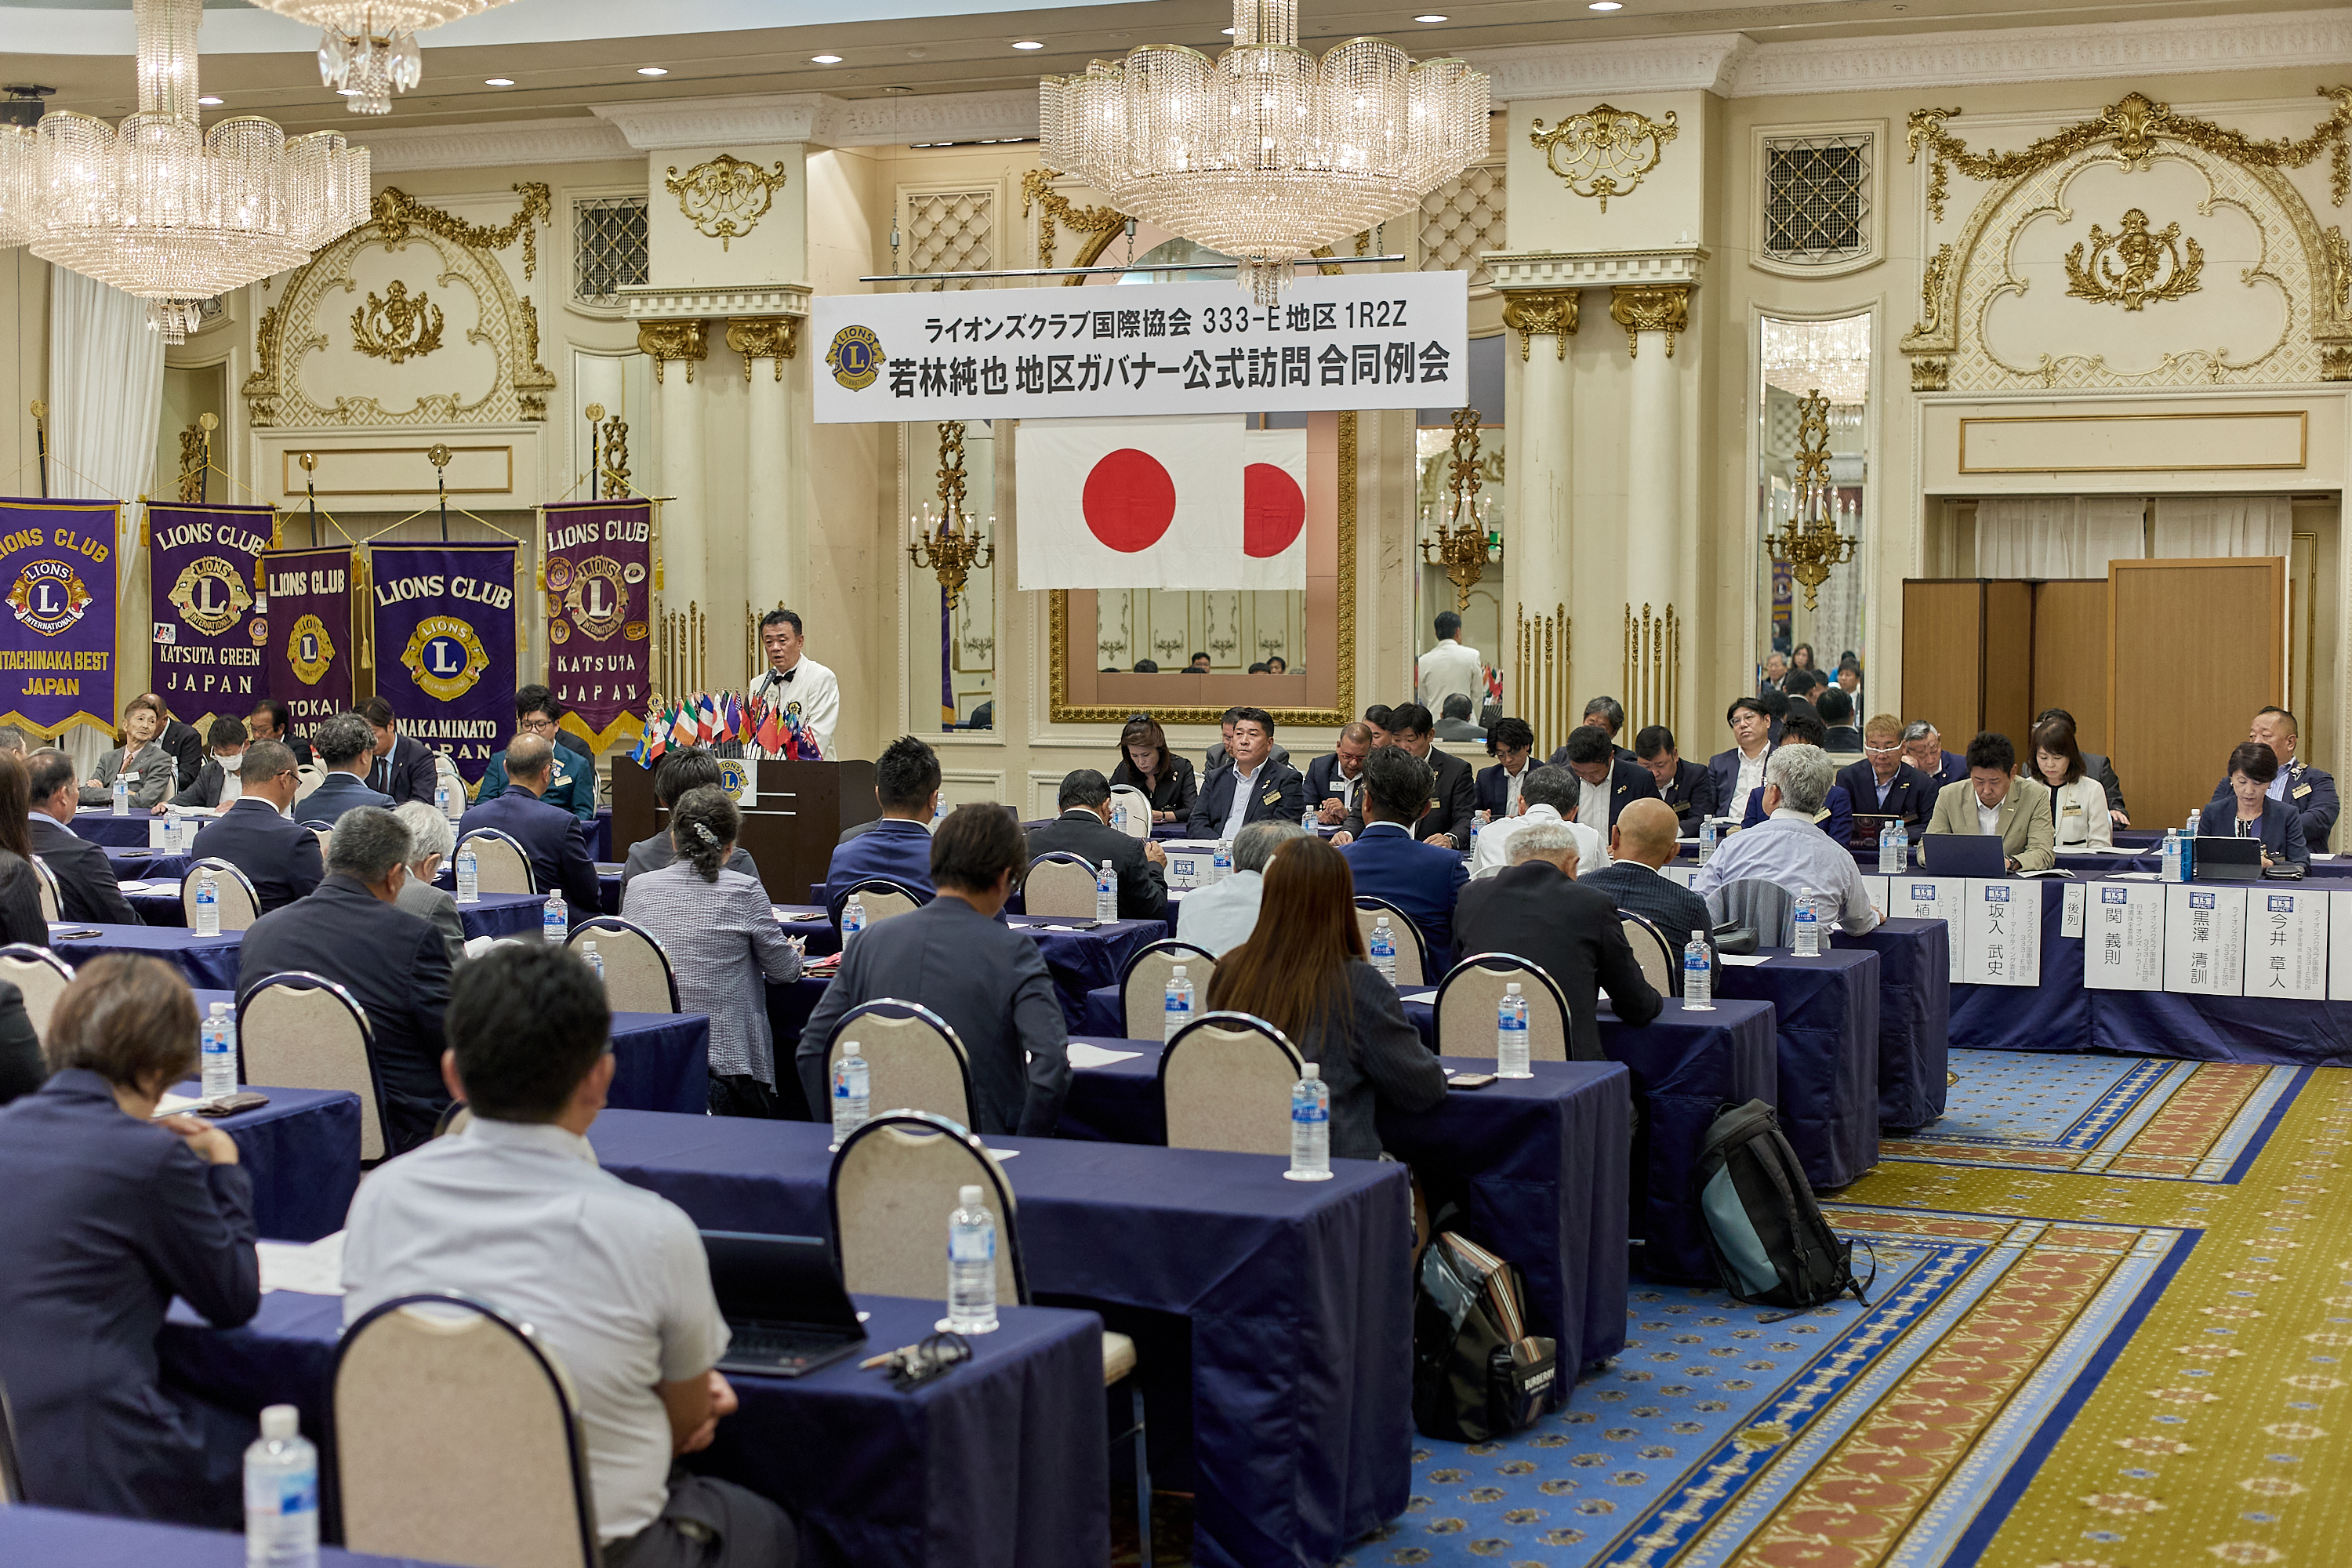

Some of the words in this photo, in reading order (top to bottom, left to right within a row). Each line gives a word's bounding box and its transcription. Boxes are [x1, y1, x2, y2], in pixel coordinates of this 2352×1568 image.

[925, 307, 1192, 343] ライオンズクラブ国際協会
[1345, 299, 1406, 328] 1R2Z
[838, 328, 873, 343] LIONS
[849, 346, 865, 368] L
[888, 354, 1009, 398] 若林純也
[1015, 346, 1311, 395] 地区ガバナー公式訪問
[1317, 340, 1450, 387] 合同例会
[839, 374, 873, 387] INTERNATIONAL
[0, 528, 44, 561] IONS
[54, 528, 109, 563] CLUB
[155, 523, 212, 551] LIONS
[216, 524, 266, 557] CLUB
[547, 522, 599, 552] LIONS
[605, 520, 650, 543] CLUB
[26, 564, 69, 580] LIONS
[194, 561, 230, 577] LIONS
[581, 559, 618, 577] LIONS
[269, 572, 307, 597] LIONS
[311, 569, 345, 594] CLUB
[374, 575, 445, 607] LIONS
[451, 576, 513, 610] CLUB
[38, 585, 60, 612] L
[199, 578, 227, 614] L
[589, 579, 613, 616] L
[24, 615, 74, 630] INTERNATIONAL
[191, 612, 233, 630] INTERNATIONAL
[299, 619, 321, 633] LIONS
[423, 621, 468, 638] LIONS
[160, 644, 216, 665] KATSUTA
[220, 647, 260, 666] GREEN
[302, 637, 317, 660] L
[432, 641, 458, 672] L
[74, 652, 109, 670] BEST
[557, 654, 635, 672] KATSUTA
[21, 677, 79, 695] JAPAN
[167, 672, 252, 694] JAPAN
[557, 684, 636, 702] JAPAN
[288, 699, 339, 717] TOKAI
[294, 722, 321, 739] JAP
[396, 718, 496, 739] NAKAMINATO
[724, 773, 735, 789] L
[2067, 902, 2079, 926] 後列
[2107, 908, 2122, 924] 関
[2193, 910, 2209, 942] 黒澤
[2270, 913, 2288, 946] 今井
[2104, 932, 2121, 965] 義則
[1525, 1367, 1555, 1391] BURBERRY
